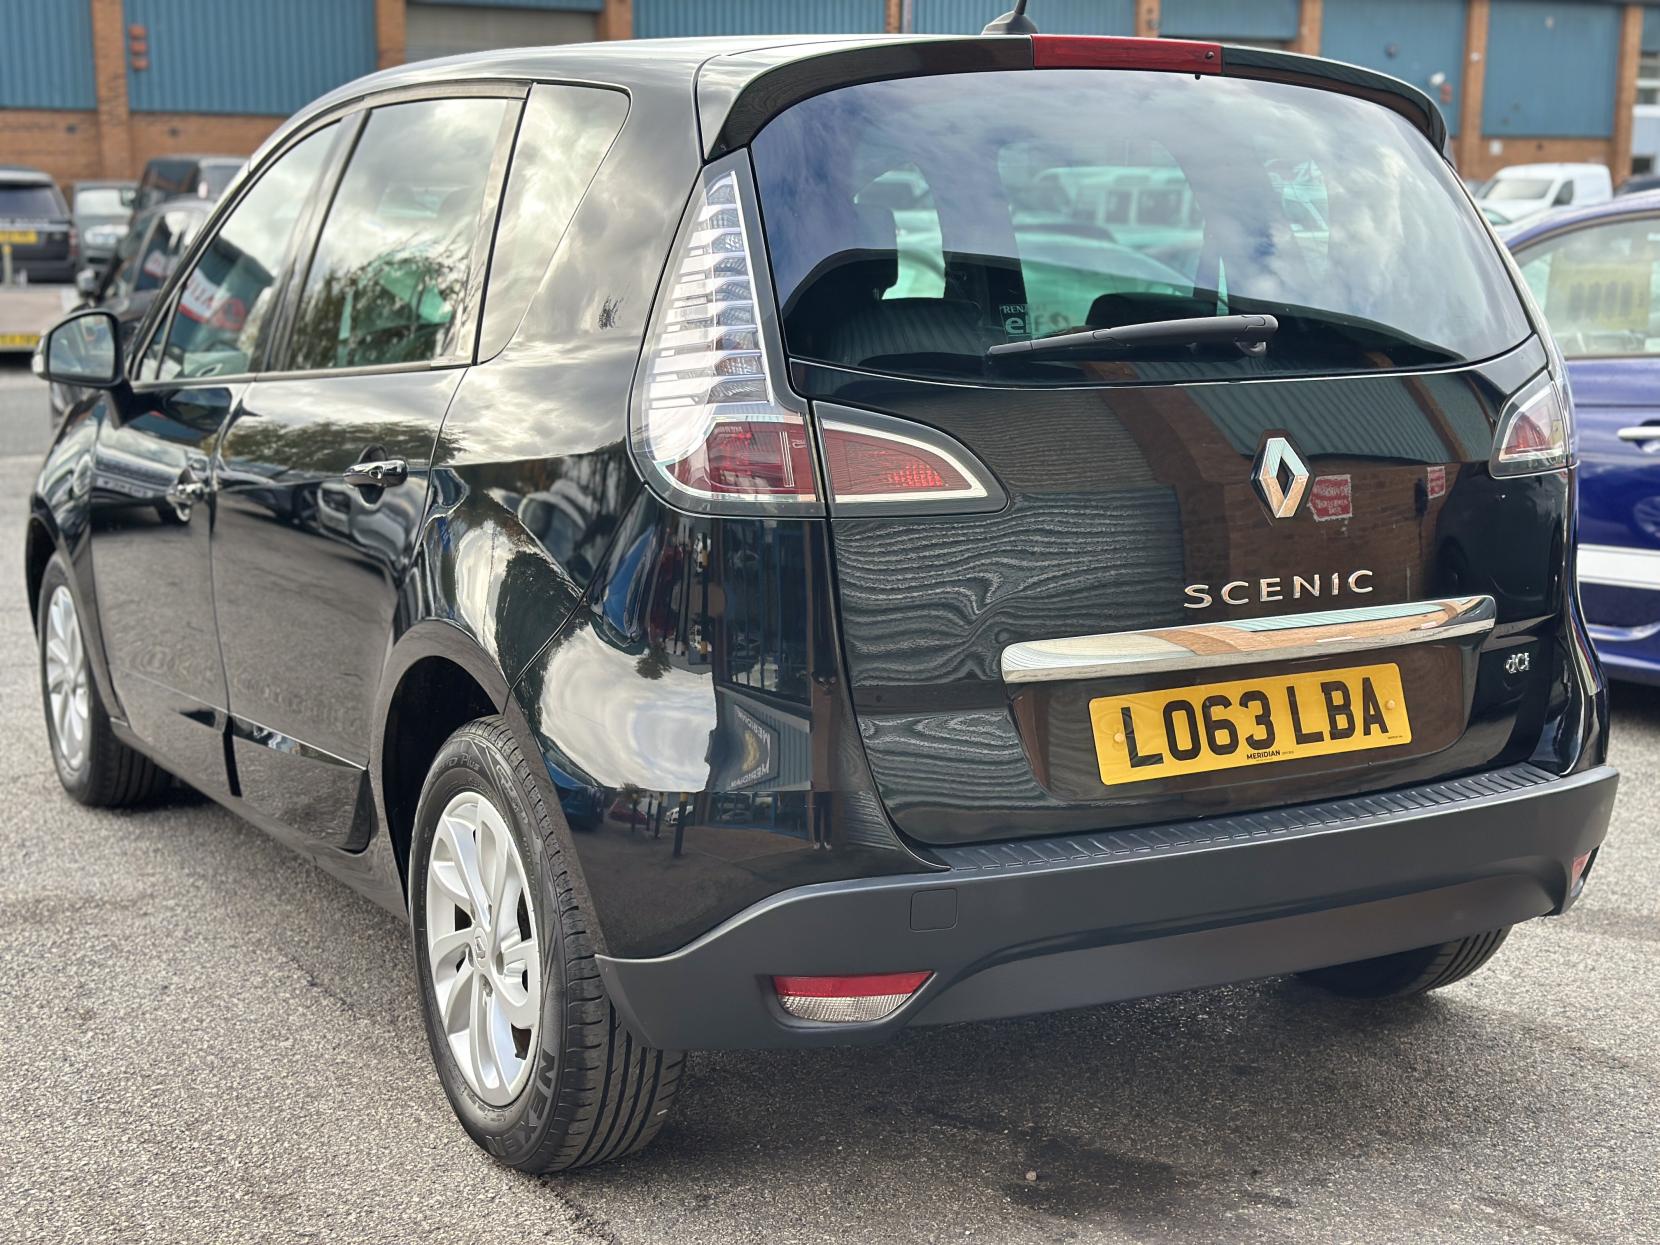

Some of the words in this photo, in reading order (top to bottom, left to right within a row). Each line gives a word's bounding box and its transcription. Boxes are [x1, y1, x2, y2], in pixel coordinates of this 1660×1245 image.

[1183, 569, 1374, 609] SCENIC
[1286, 677, 1390, 745] LBA
[1246, 750, 1281, 760] MERIDIAN
